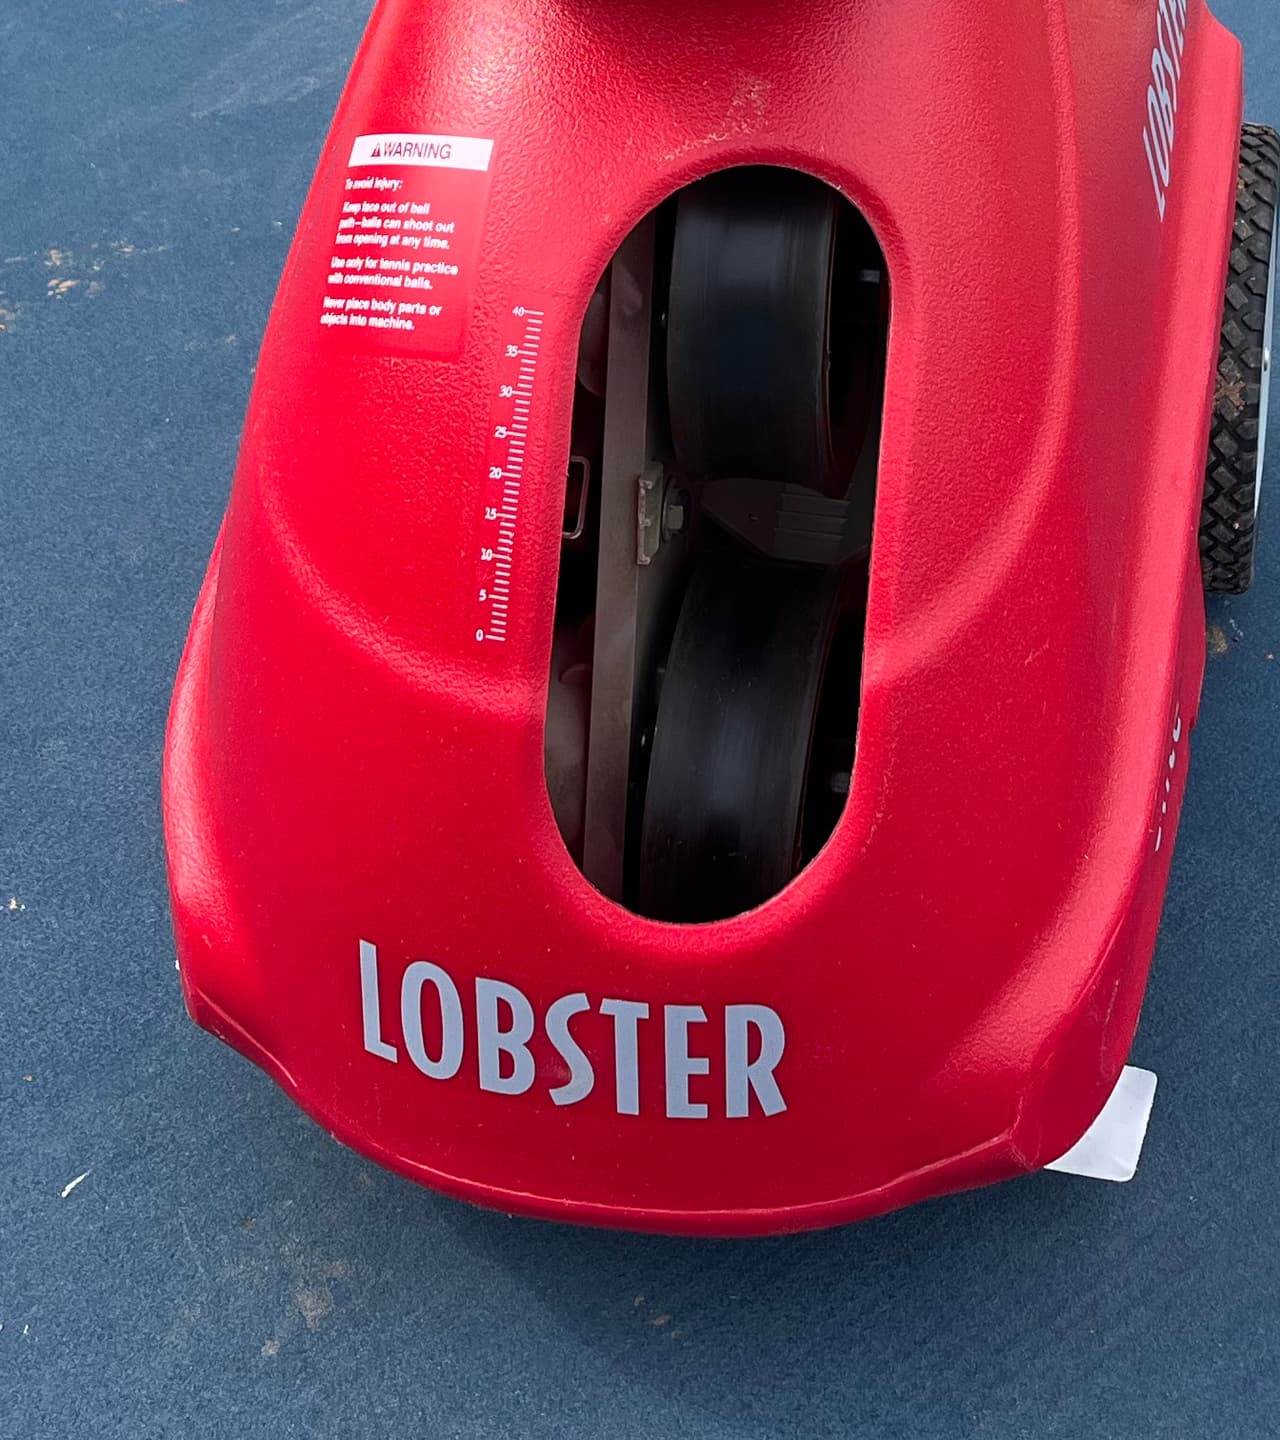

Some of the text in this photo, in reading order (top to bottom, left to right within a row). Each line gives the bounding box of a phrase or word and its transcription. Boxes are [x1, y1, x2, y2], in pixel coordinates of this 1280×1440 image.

[383, 142, 452, 159] WARNING
[374, 176, 403, 191] injury:
[342, 201, 430, 215] Keep face out of ball
[383, 219, 401, 230] can
[403, 218, 433, 231] shoot
[435, 222, 455, 233] out
[335, 232, 450, 249] from opening at any time.
[331, 256, 458, 275] Use only for tennis practice
[328, 272, 433, 290] with conventional balls.
[323, 296, 442, 316] Never place body parts or
[512, 306, 525, 317] 40
[320, 312, 415, 330] objects into machine.
[505, 345, 518, 357] 35
[499, 385, 513, 397] 30
[494, 426, 508, 438] 25
[489, 467, 502, 479] 20
[485, 507, 497, 520] 15
[481, 548, 493, 561] 10
[479, 589, 487, 601] 5
[476, 629, 484, 641] 0
[359, 939, 788, 1119] LOBSTER
